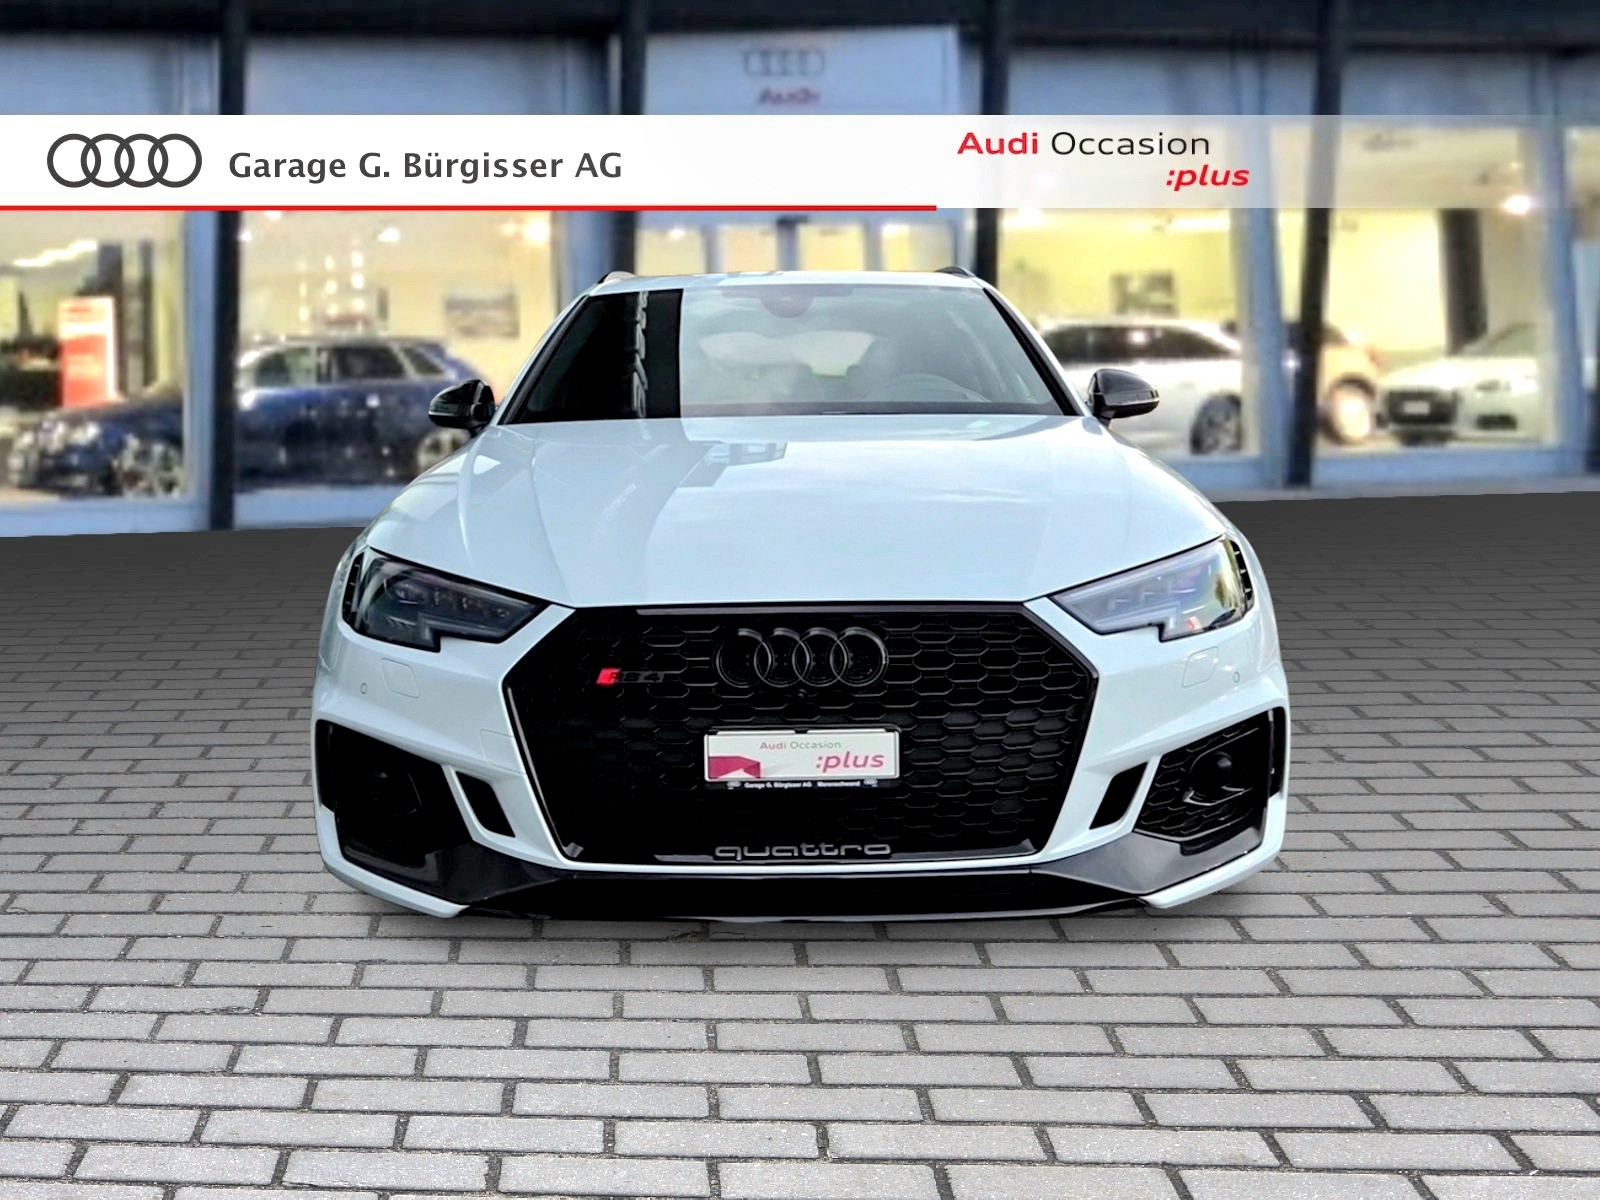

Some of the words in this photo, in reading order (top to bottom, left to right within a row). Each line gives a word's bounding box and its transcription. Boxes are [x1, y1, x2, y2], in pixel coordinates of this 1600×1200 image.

[760, 741, 787, 750] Audi
[790, 740, 842, 750] Occasion
[715, 842, 891, 861] quattro
